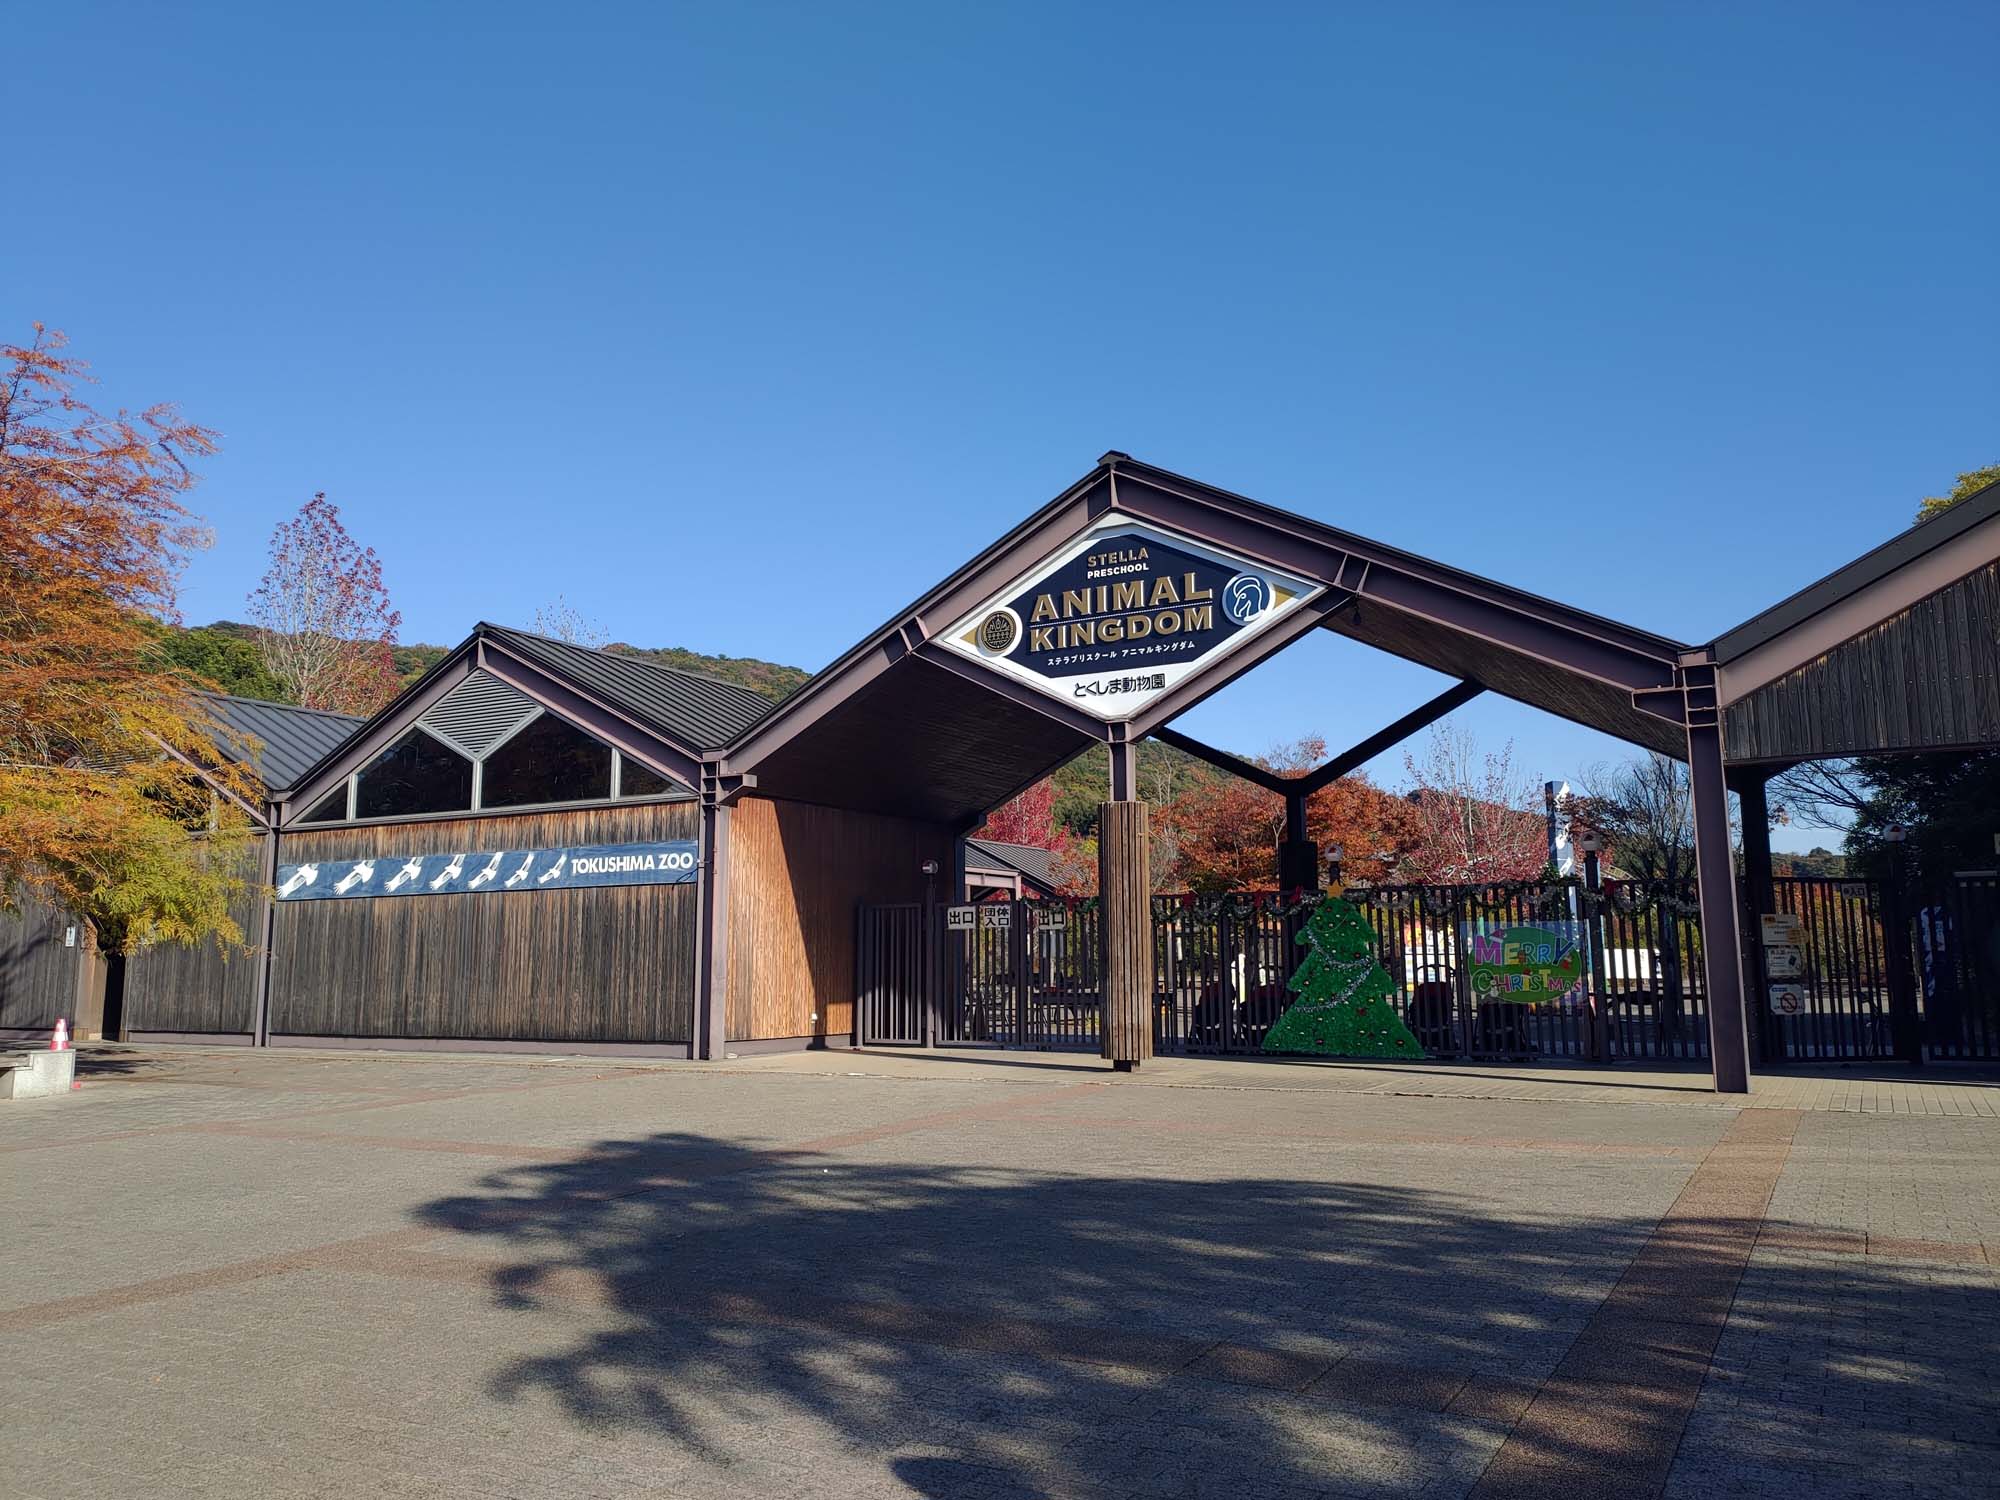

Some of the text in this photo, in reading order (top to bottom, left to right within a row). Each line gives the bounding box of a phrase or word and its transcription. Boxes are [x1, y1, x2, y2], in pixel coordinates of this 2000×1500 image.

[1087, 547, 1149, 567] STELLA
[1087, 563, 1149, 579] PRESCHOOL
[1030, 572, 1213, 623] ANIMAL
[1030, 606, 1213, 652] KINGDOM
[1121, 640, 1195, 656] アニマルキングダム
[1074, 673, 1166, 697] とくしま動物園
[571, 852, 694, 874] TOKUSHIMA ZOO
[949, 911, 974, 925] 出口
[985, 907, 1009, 917] 団体
[986, 917, 1009, 927] 入口
[1038, 911, 1064, 926] 出口
[1475, 935, 1574, 965] MERRY
[1472, 969, 1582, 995] CHRISTMAS
